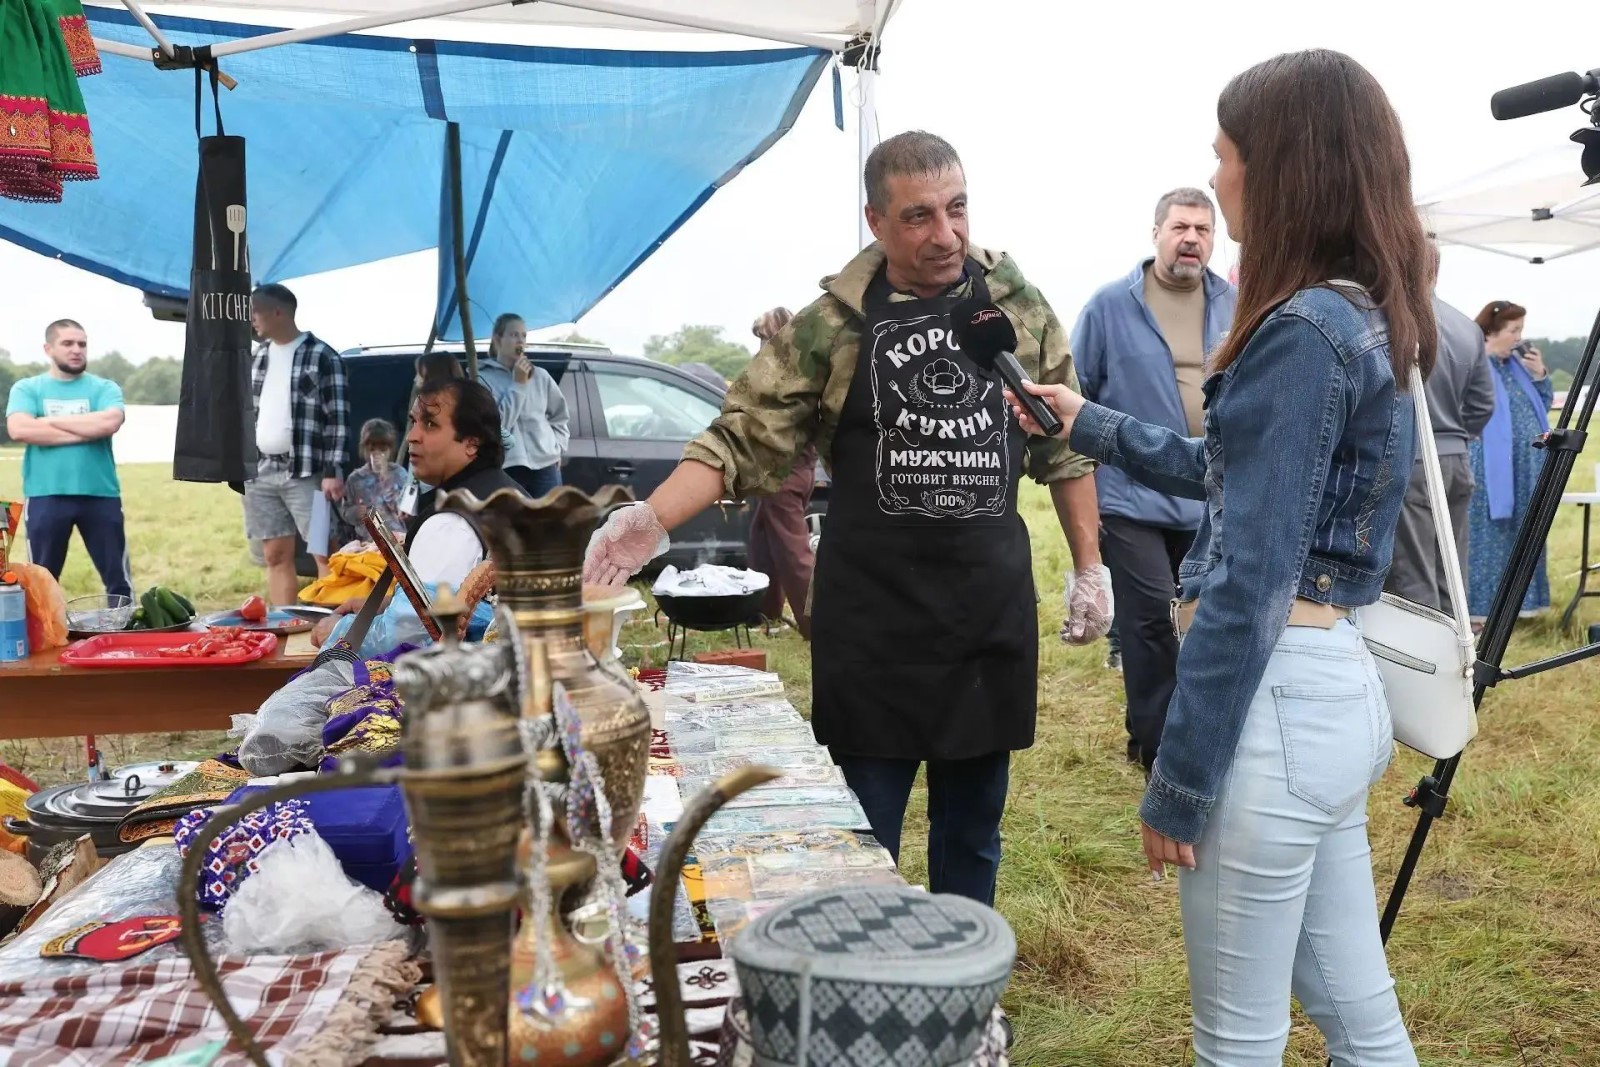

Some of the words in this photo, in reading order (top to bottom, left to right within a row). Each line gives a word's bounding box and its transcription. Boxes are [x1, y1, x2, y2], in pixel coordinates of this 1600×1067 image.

[885, 328, 960, 368] КОРО
[896, 408, 993, 439] КУХНИ
[890, 450, 1001, 468] МУЖЧИНА
[891, 473, 947, 485] ГОТОВИТ
[952, 474, 1000, 486] ВКУСНЕЕ
[935, 494, 965, 507] 100%
